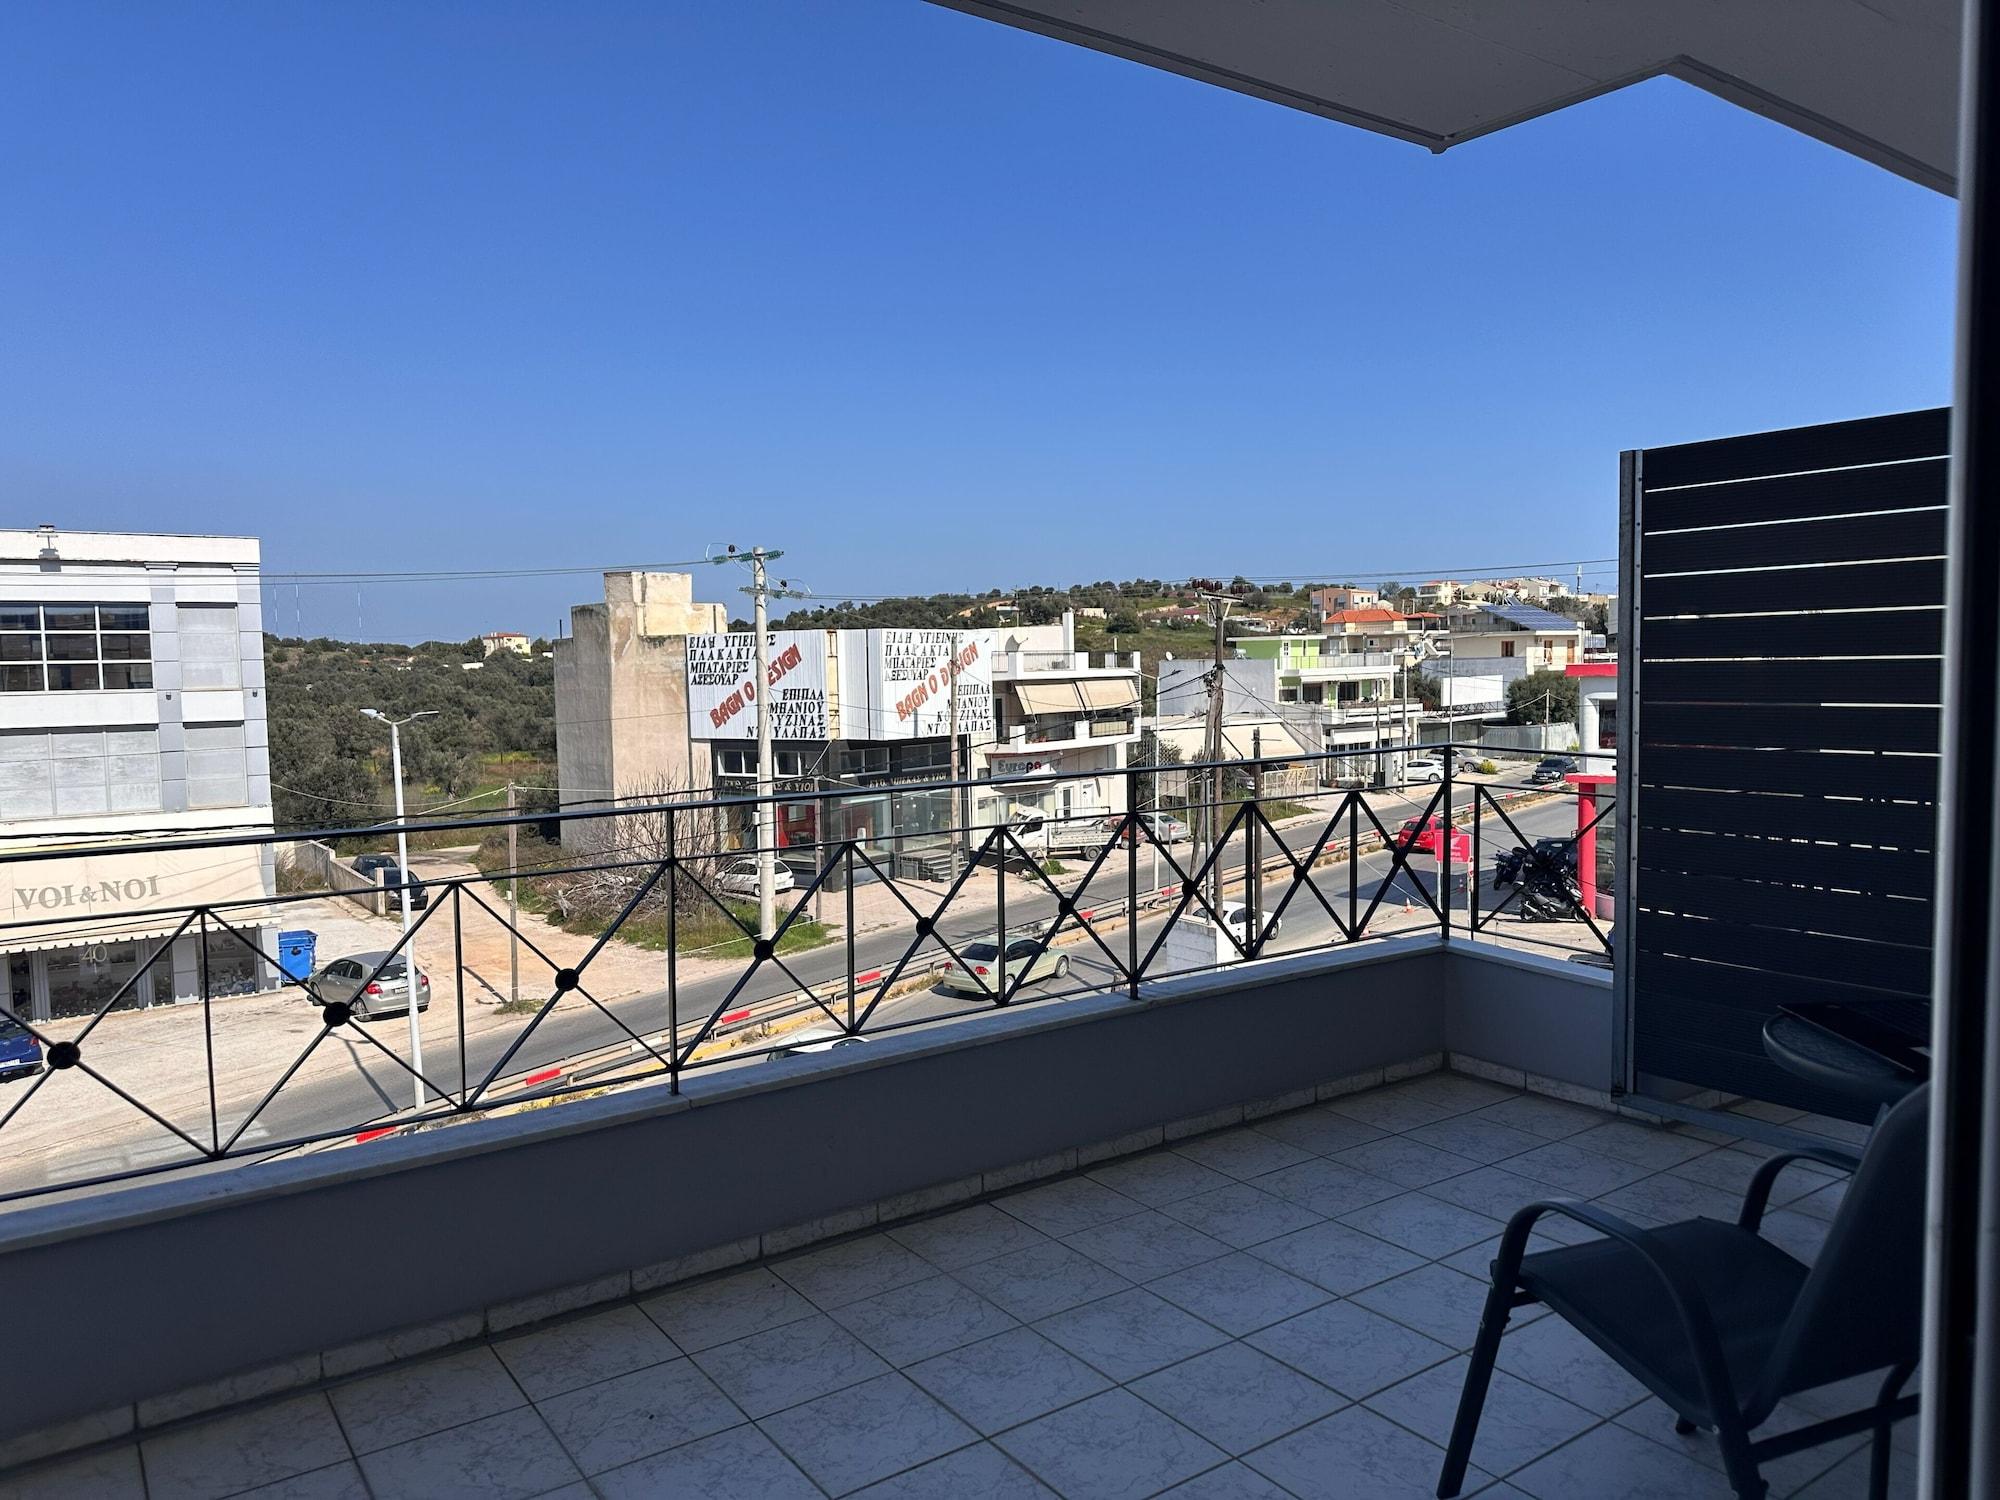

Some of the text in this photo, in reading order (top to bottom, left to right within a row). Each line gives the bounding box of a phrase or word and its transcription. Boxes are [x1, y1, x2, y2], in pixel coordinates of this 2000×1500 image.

[689, 634, 776, 649] ΕΙΔΗ ΥΓΙΕΙΣ
[690, 661, 749, 674] ΜΠΑΤΑΡΙΕΣ
[709, 690, 745, 729] BAGN
[757, 643, 802, 687] ESIGN
[957, 683, 991, 696] ΕΠΙΠΛΑ
[782, 688, 824, 701] ΕΠΙΠΛΑ
[895, 682, 929, 722] BAGN
[769, 714, 825, 727] ΥΖΙΝΑΣ
[937, 709, 990, 722] ΚΟΖΙΝΑΣ
[746, 726, 826, 739] ΝΥΛΑΠΑΣ
